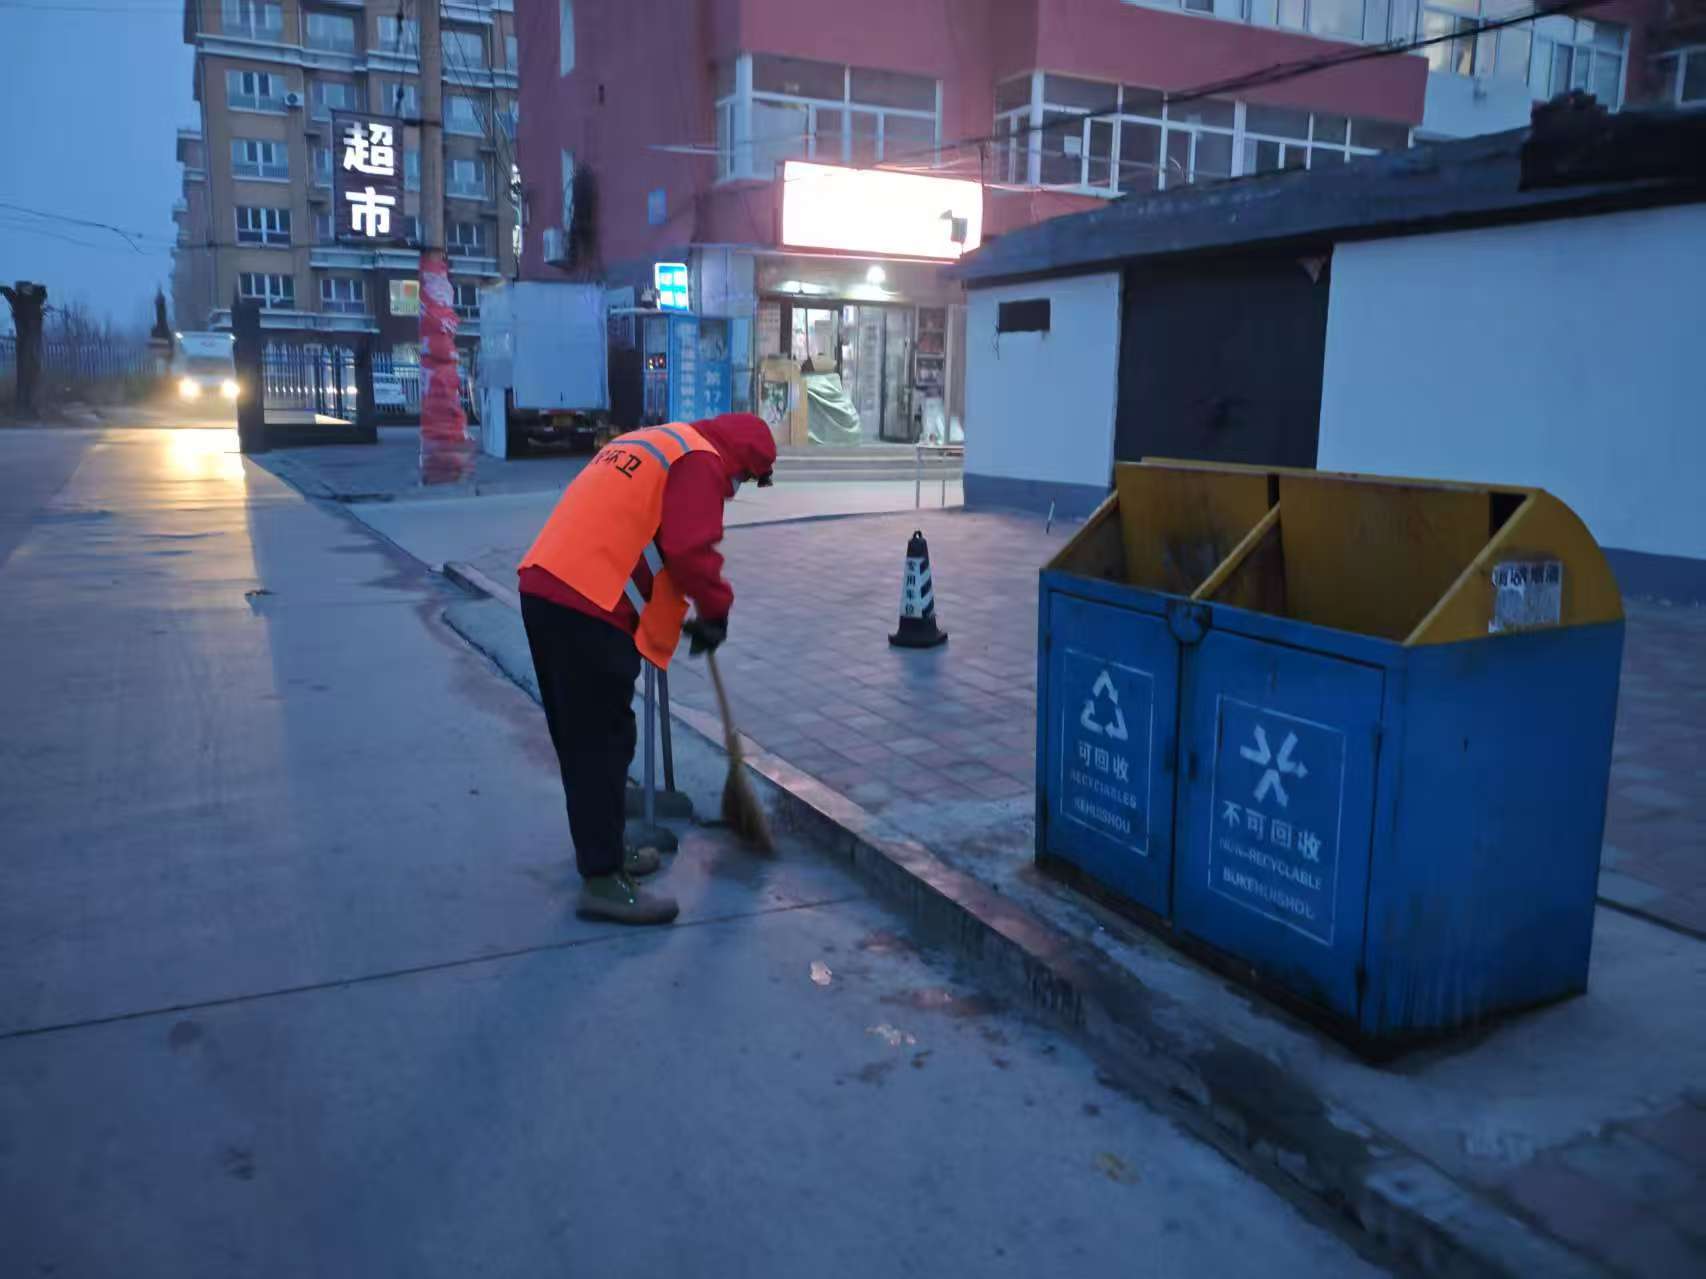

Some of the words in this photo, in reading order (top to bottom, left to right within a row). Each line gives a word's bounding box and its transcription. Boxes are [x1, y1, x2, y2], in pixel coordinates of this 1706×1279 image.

[343, 121, 396, 237] 超市
[1079, 740, 1129, 783] 可回收
[1223, 800, 1321, 863] 不可回收
